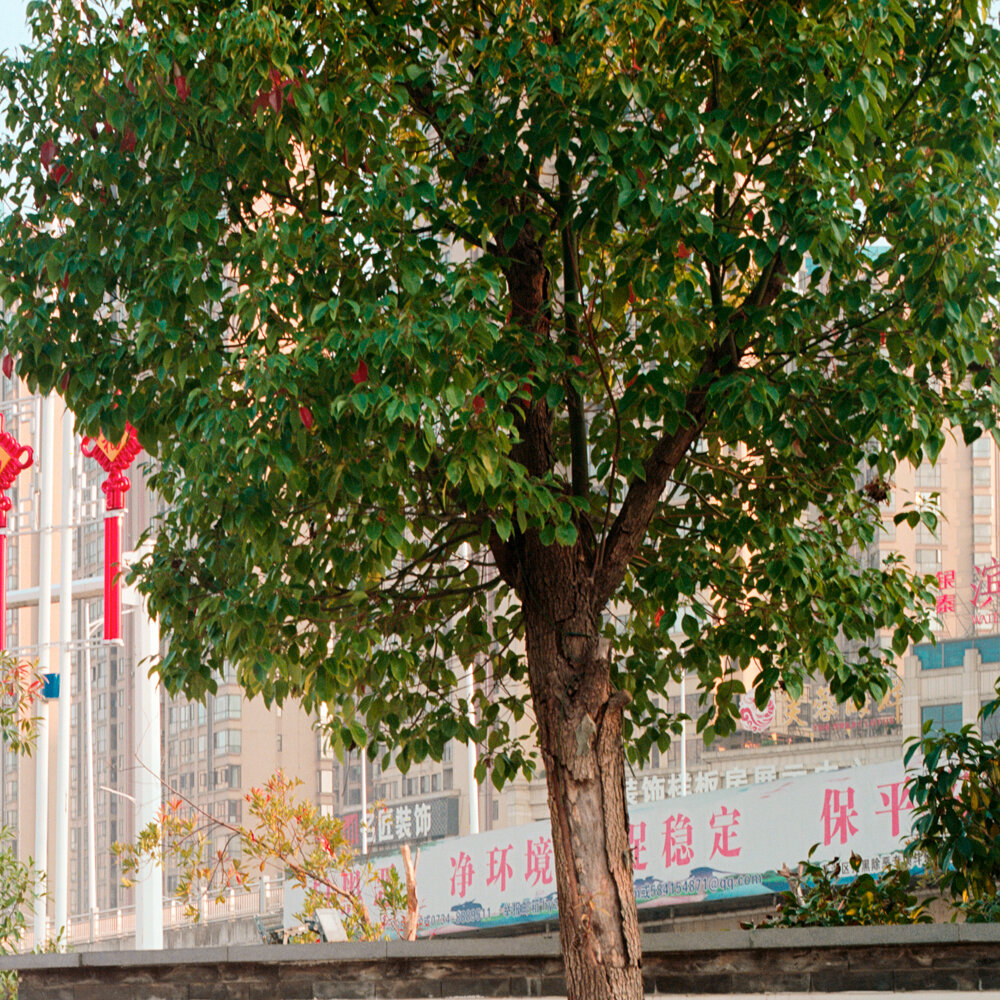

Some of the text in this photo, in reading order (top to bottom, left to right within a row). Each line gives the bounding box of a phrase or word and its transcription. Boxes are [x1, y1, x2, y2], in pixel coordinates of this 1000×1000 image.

[936, 569, 955, 614] 银泰
[360, 803, 432, 843] 名匠装饰
[450, 837, 553, 898] 净环境
[820, 770, 960, 846] 保平
